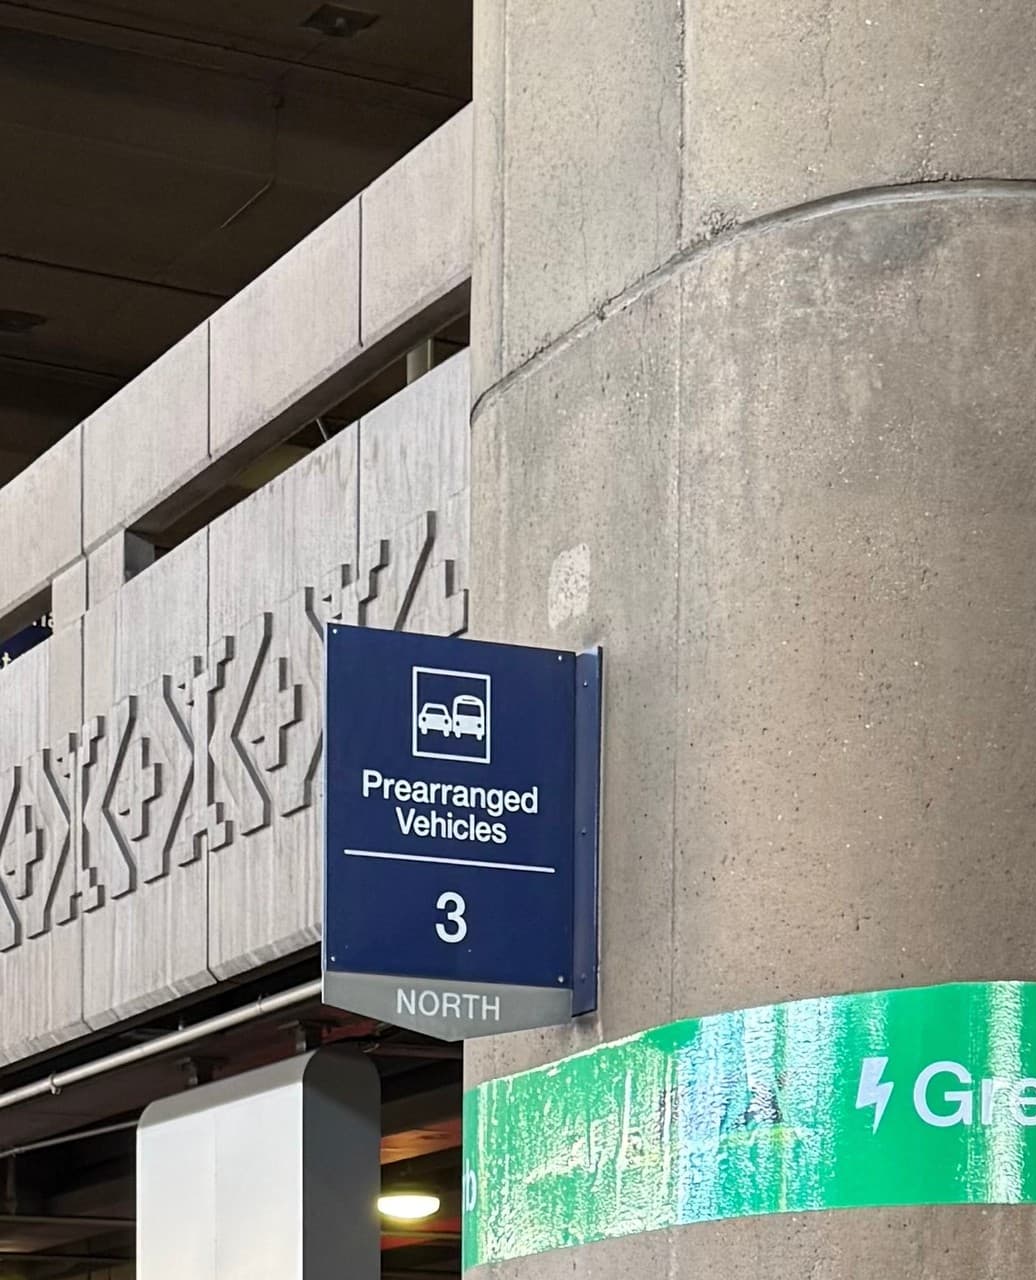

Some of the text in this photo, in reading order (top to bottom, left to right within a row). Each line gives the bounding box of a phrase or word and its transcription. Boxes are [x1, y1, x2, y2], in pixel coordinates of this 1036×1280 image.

[362, 769, 538, 816] Prearranged
[395, 807, 507, 843] Vehicles
[435, 891, 468, 944] 3
[396, 988, 500, 1021] NORTH
